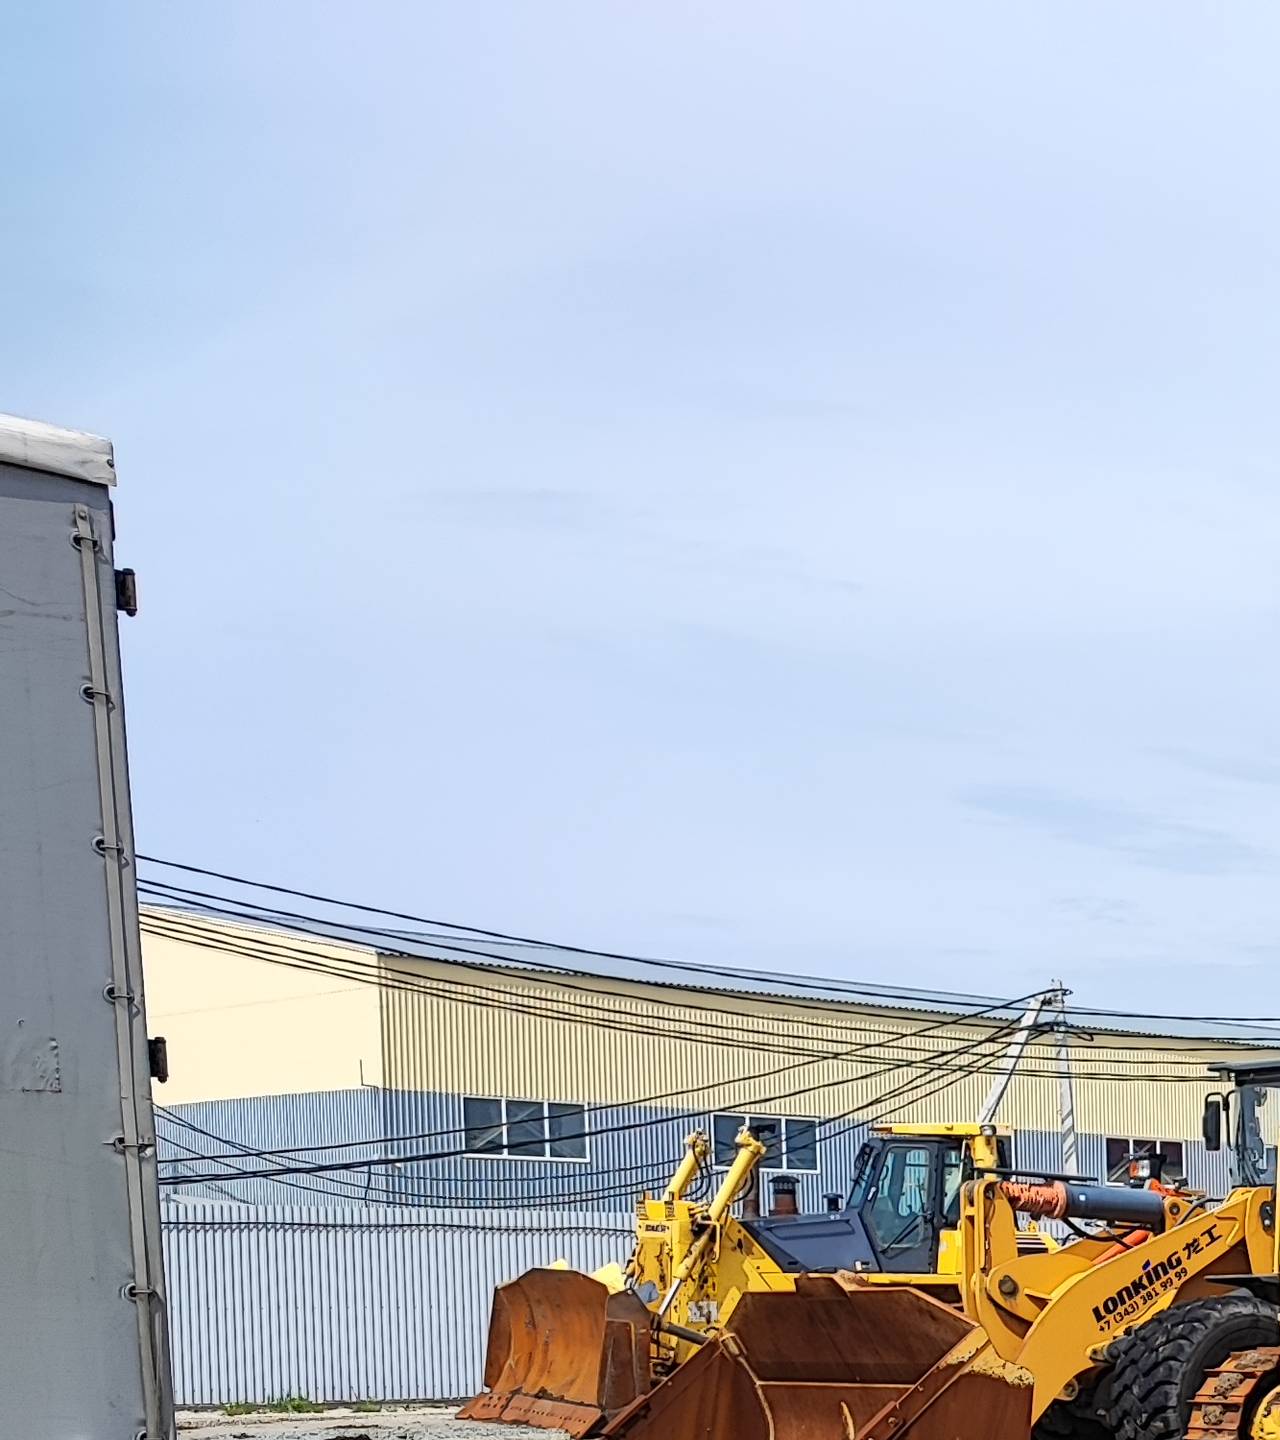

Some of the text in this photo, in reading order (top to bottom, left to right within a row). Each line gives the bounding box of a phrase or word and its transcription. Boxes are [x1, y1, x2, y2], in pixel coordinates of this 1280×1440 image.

[1098, 1321, 1111, 1332] +7
[1113, 1301, 1140, 1325] (343)
[1140, 1287, 1160, 1306] 381
[1175, 1267, 1189, 1280] 99
